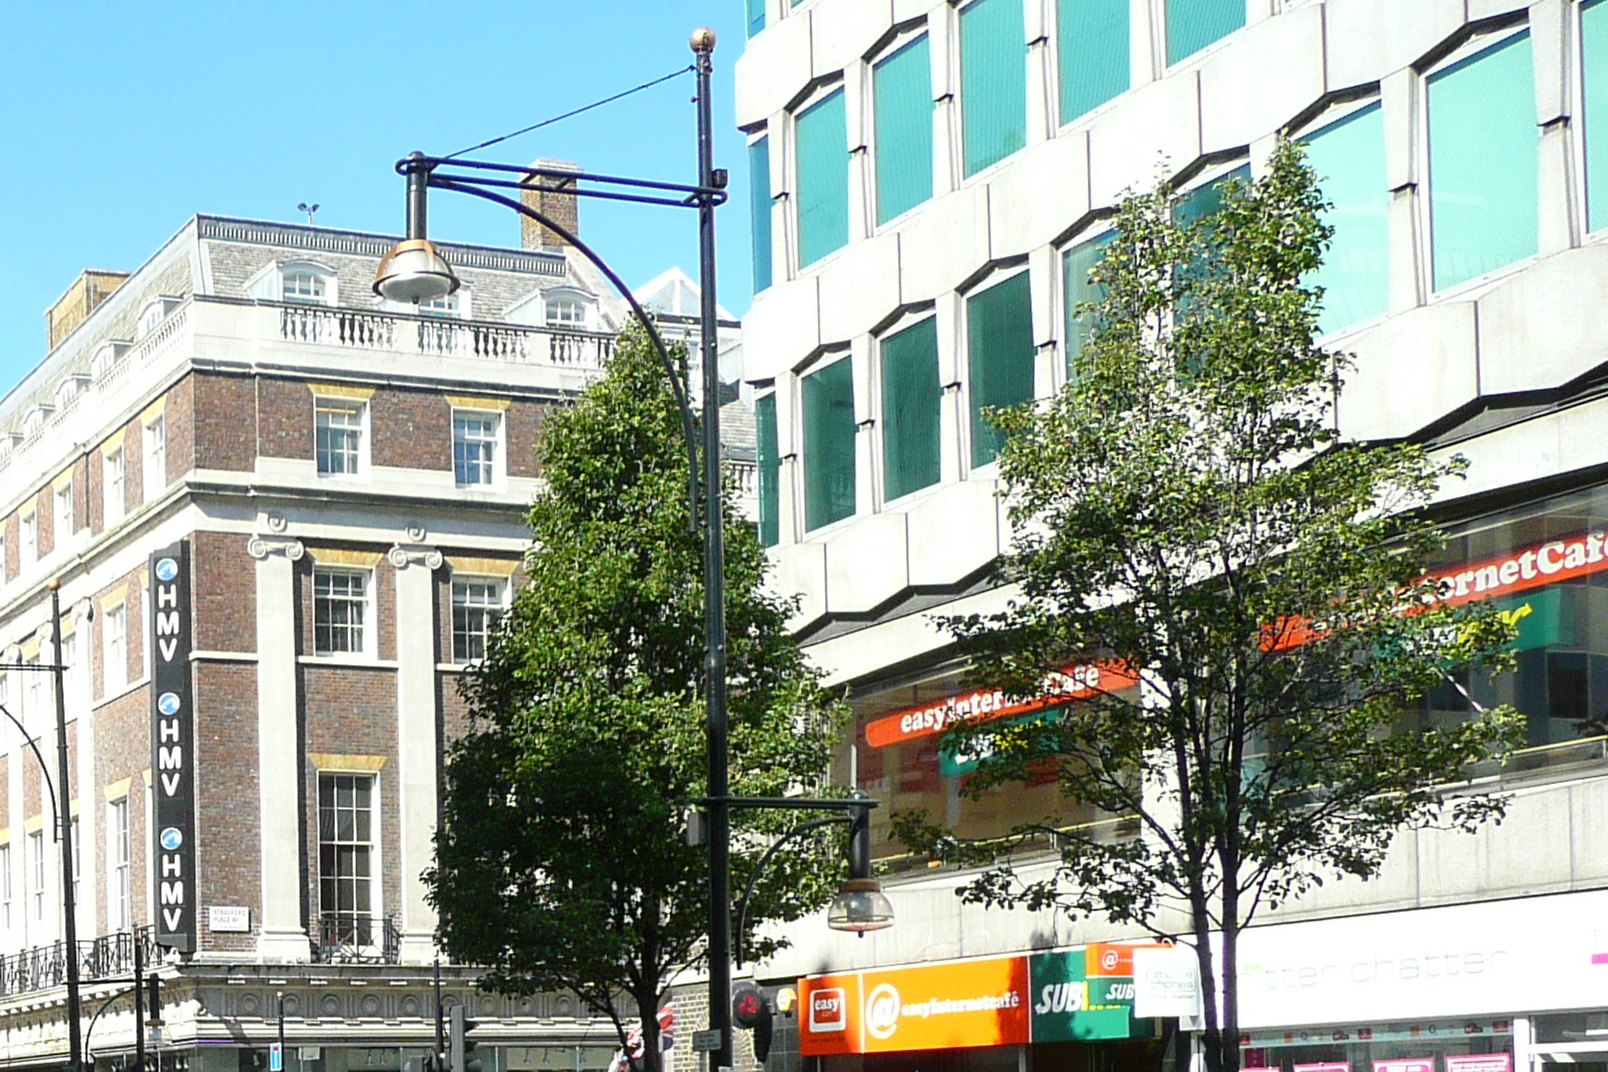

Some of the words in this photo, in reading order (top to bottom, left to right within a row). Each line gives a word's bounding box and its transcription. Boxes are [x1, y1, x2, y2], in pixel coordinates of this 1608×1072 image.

[157, 584, 179, 662] HMV
[159, 718, 181, 797] HMV
[161, 854, 183, 931] HMV
[815, 996, 840, 1012] easy
[1350, 947, 1508, 985] chatter
